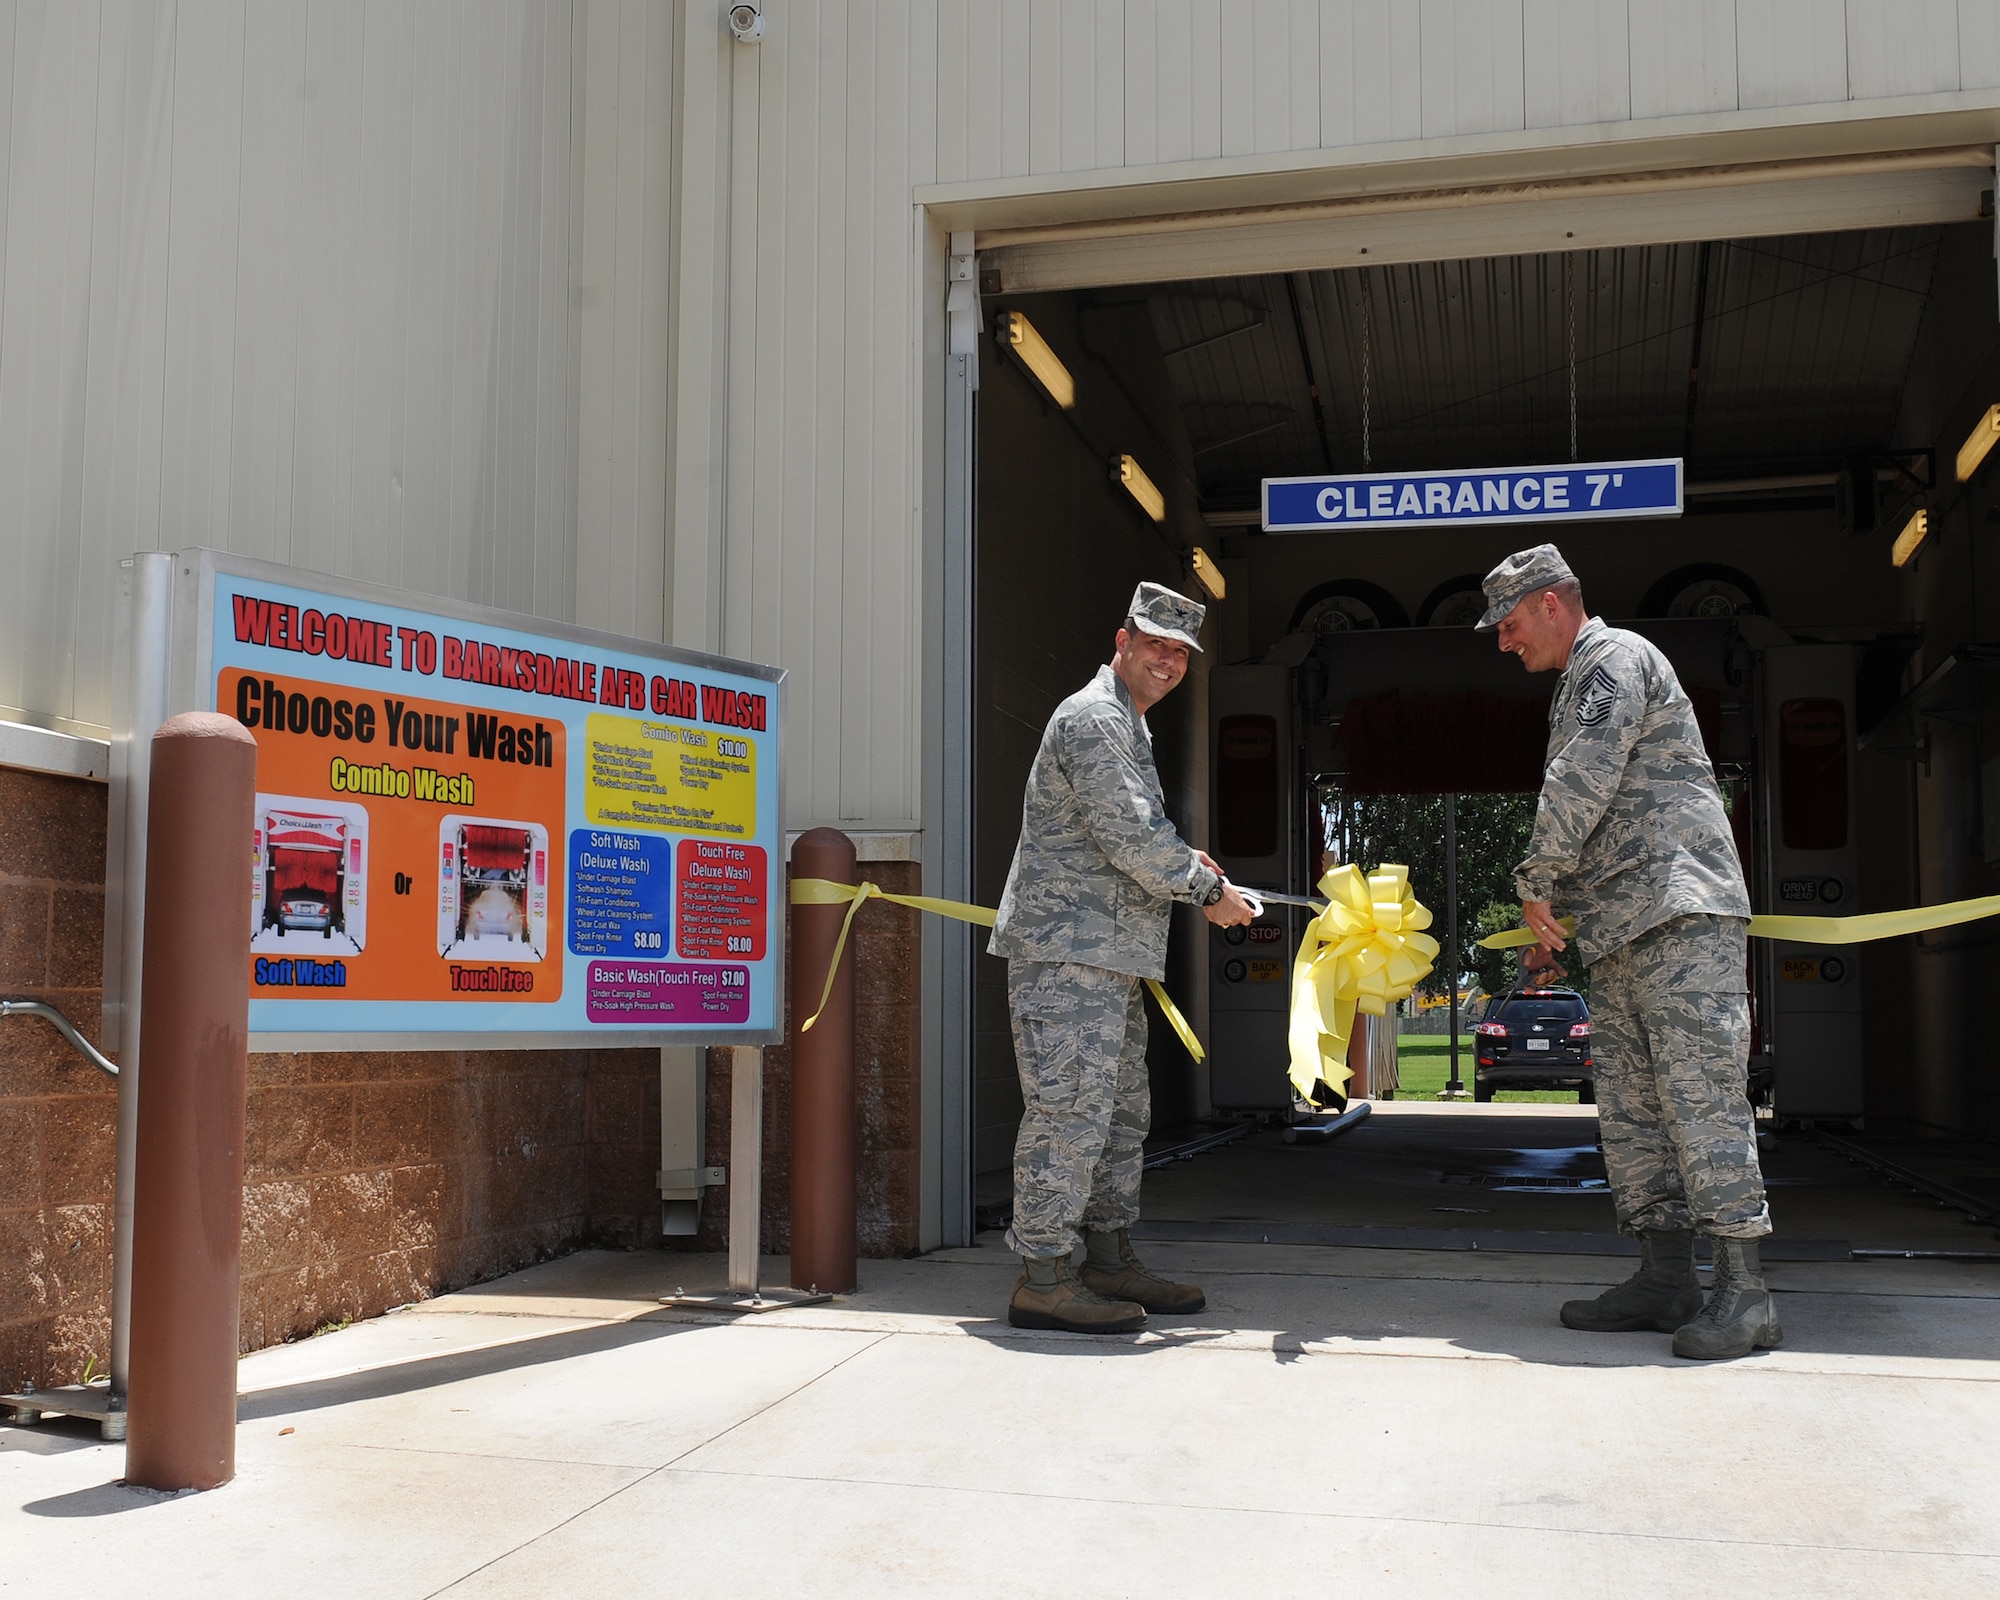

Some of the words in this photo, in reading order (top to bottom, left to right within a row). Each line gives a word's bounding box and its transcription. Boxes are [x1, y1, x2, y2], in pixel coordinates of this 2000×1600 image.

[1315, 477, 1569, 520] CLEARANCE
[1585, 473, 1624, 507] 7'
[232, 593, 392, 668] WELCOME
[398, 626, 436, 675] TO
[443, 635, 596, 704] BARKSDALE
[600, 666, 646, 711] AFB
[650, 675, 697, 720] CAR
[701, 685, 766, 732] WASH
[237, 675, 375, 744] Choose
[384, 699, 460, 755] Your
[466, 712, 552, 768] Wash
[641, 722, 678, 742] Combo
[681, 730, 708, 747] Wash
[718, 737, 747, 759] $10.00
[330, 756, 410, 799] Combo
[413, 766, 474, 806] Wash
[590, 832, 611, 849] Soft
[613, 834, 641, 851] Wash
[696, 842, 724, 859] Touch
[725, 845, 746, 860] Free
[579, 852, 618, 870] (Deluxe
[620, 855, 650, 875] Wash)
[689, 862, 723, 879] (Deluxe
[725, 865, 752, 883] Wash)
[394, 871, 413, 895] Or
[596, 873, 621, 885] Carriage
[621, 875, 637, 885] Blast
[1783, 882, 1814, 892] DRIVE
[605, 885, 633, 896] Shampoo
[604, 897, 640, 908] Conditioners
[596, 909, 606, 917] Jet
[606, 909, 632, 920] Cleaning
[632, 911, 654, 921] System
[593, 920, 607, 929] Coat
[608, 921, 620, 930] Wax
[1250, 928, 1280, 940] STOP
[591, 932, 605, 941] Free
[606, 932, 622, 942] Rinse
[634, 931, 661, 949] $8.00
[727, 935, 752, 953] $8.00
[596, 943, 607, 954] Dry
[255, 957, 294, 985] Soft
[294, 959, 346, 987] Wash
[1252, 963, 1279, 972] BACK
[1785, 962, 1814, 971] BACK
[1794, 971, 1806, 979] UP
[450, 965, 499, 992] Touch
[500, 967, 534, 992] Free
[594, 967, 624, 983] Basic
[692, 971, 717, 988] Free)
[721, 969, 745, 987] $7.00
[611, 989, 636, 1000] Carriage
[636, 990, 651, 998] Blast
[620, 1001, 633, 1012] High
[634, 1001, 659, 1010] Pressure
[660, 1002, 675, 1010] Wash
